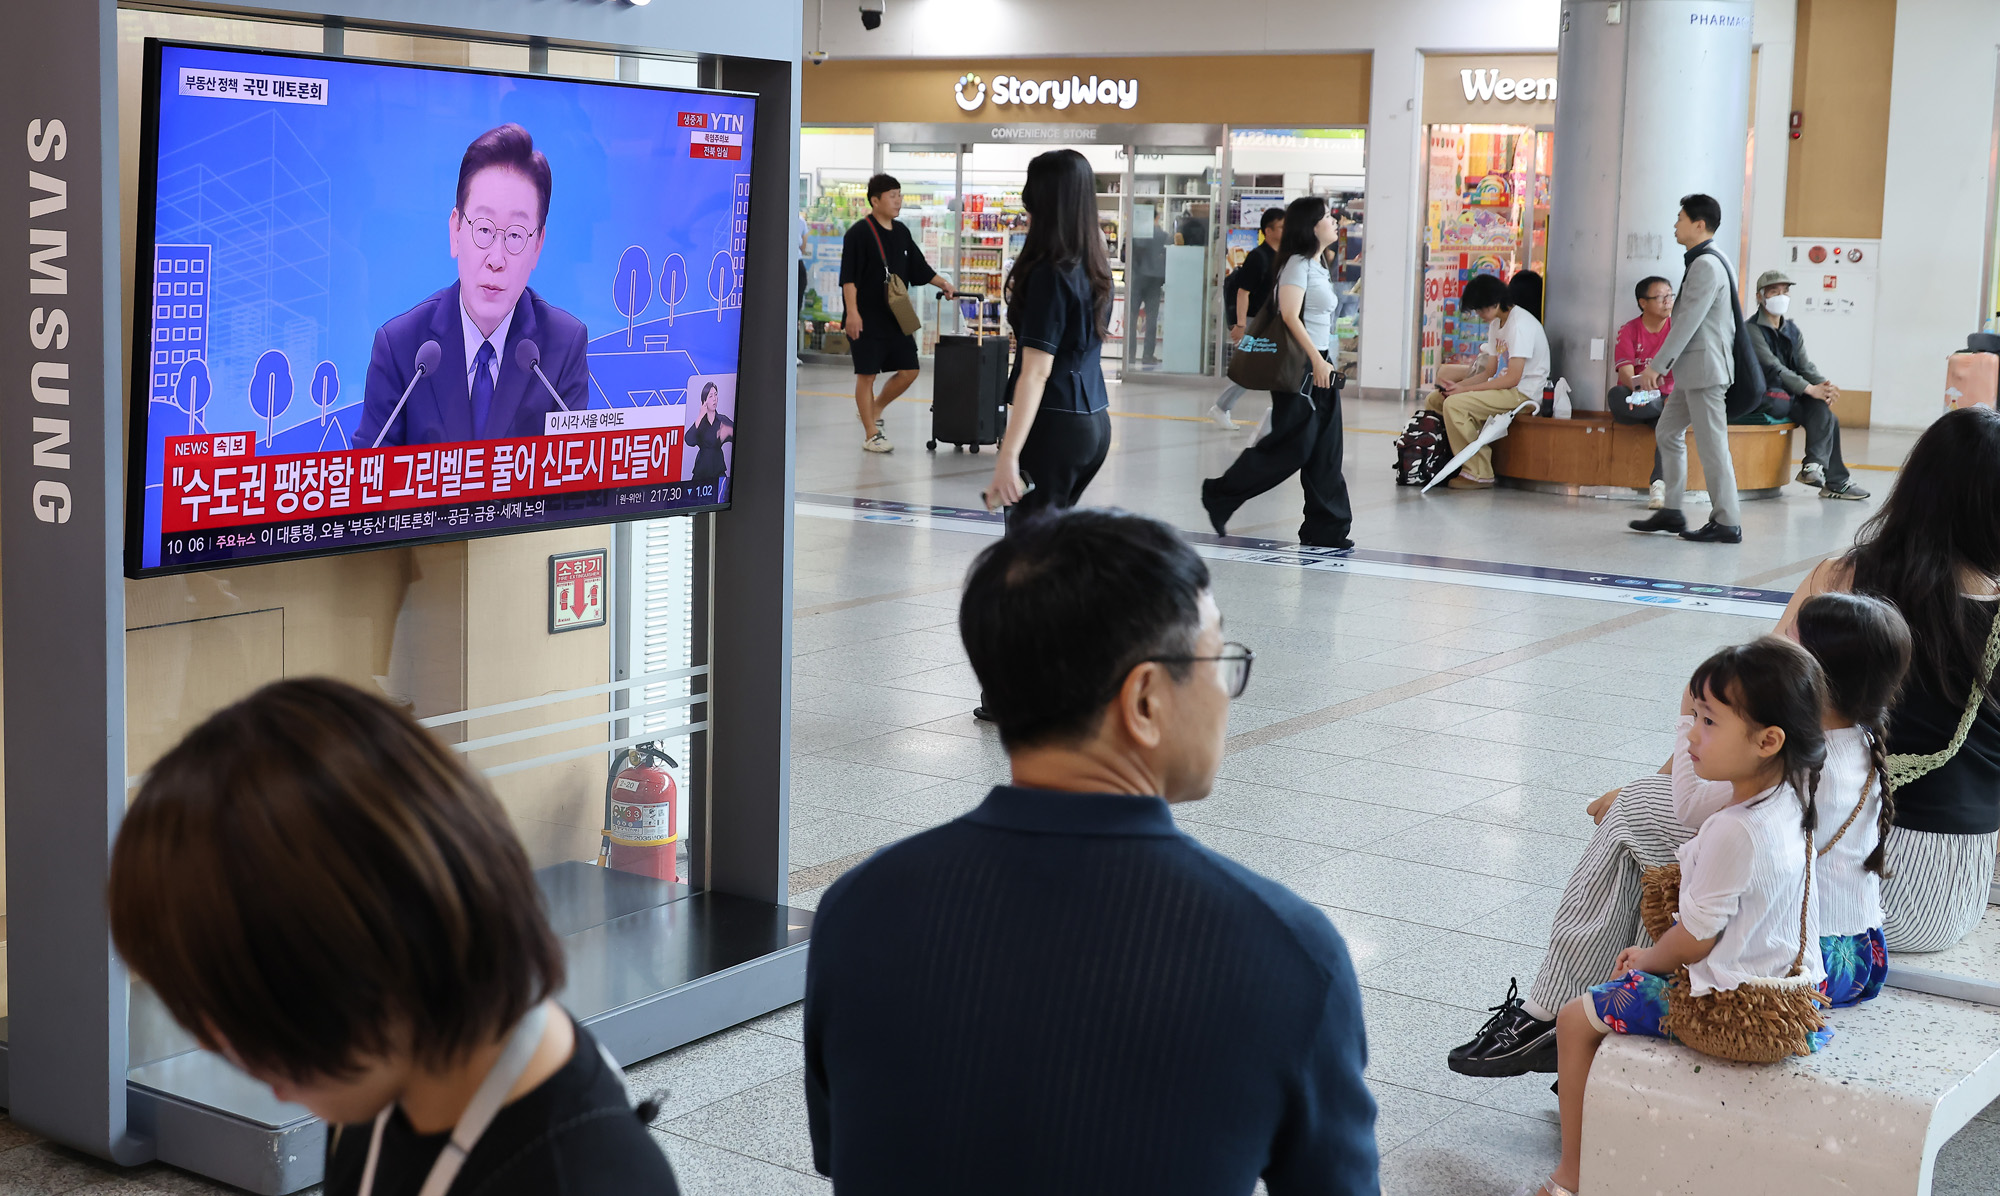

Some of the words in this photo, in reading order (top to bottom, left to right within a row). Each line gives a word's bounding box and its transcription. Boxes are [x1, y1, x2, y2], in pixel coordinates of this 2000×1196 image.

[185, 75, 216, 91] 부동산
[218, 77, 238, 93] 정책
[243, 78, 268, 96] 국민
[273, 80, 322, 100] 대토론회
[991, 75, 1138, 110] StoryWay
[683, 113, 703, 126] 생중계
[710, 112, 744, 132] YTN
[991, 127, 1060, 139] CONVENIENCE
[1063, 128, 1097, 139] STORE
[703, 146, 716, 157] 전북
[27, 118, 72, 524] SAMSUNG
[551, 416, 559, 430] 이
[561, 415, 579, 430] 시각
[581, 414, 598, 428] 서울
[599, 412, 625, 428] 여의도
[174, 441, 209, 456] NEWS
[214, 435, 246, 457] 속보
[172, 463, 267, 523] "수도권
[273, 456, 354, 514] 팽창할
[360, 454, 385, 505] 땐
[389, 447, 486, 500] 그린벨트
[490, 441, 536, 493] 풀어
[541, 436, 605, 488] 신도시
[610, 429, 678, 481] 만들어"
[650, 487, 682, 503] 217.30
[696, 485, 713, 497] 1.02
[261, 527, 273, 545] 이
[277, 523, 318, 545] 대통령,
[320, 521, 345, 539] 오늘
[348, 515, 386, 535] '부동산
[524, 499, 545, 518] 논의
[216, 533, 256, 550] 주요뉴스
[558, 558, 600, 577] 소화기
[620, 780, 635, 789] 2-20
